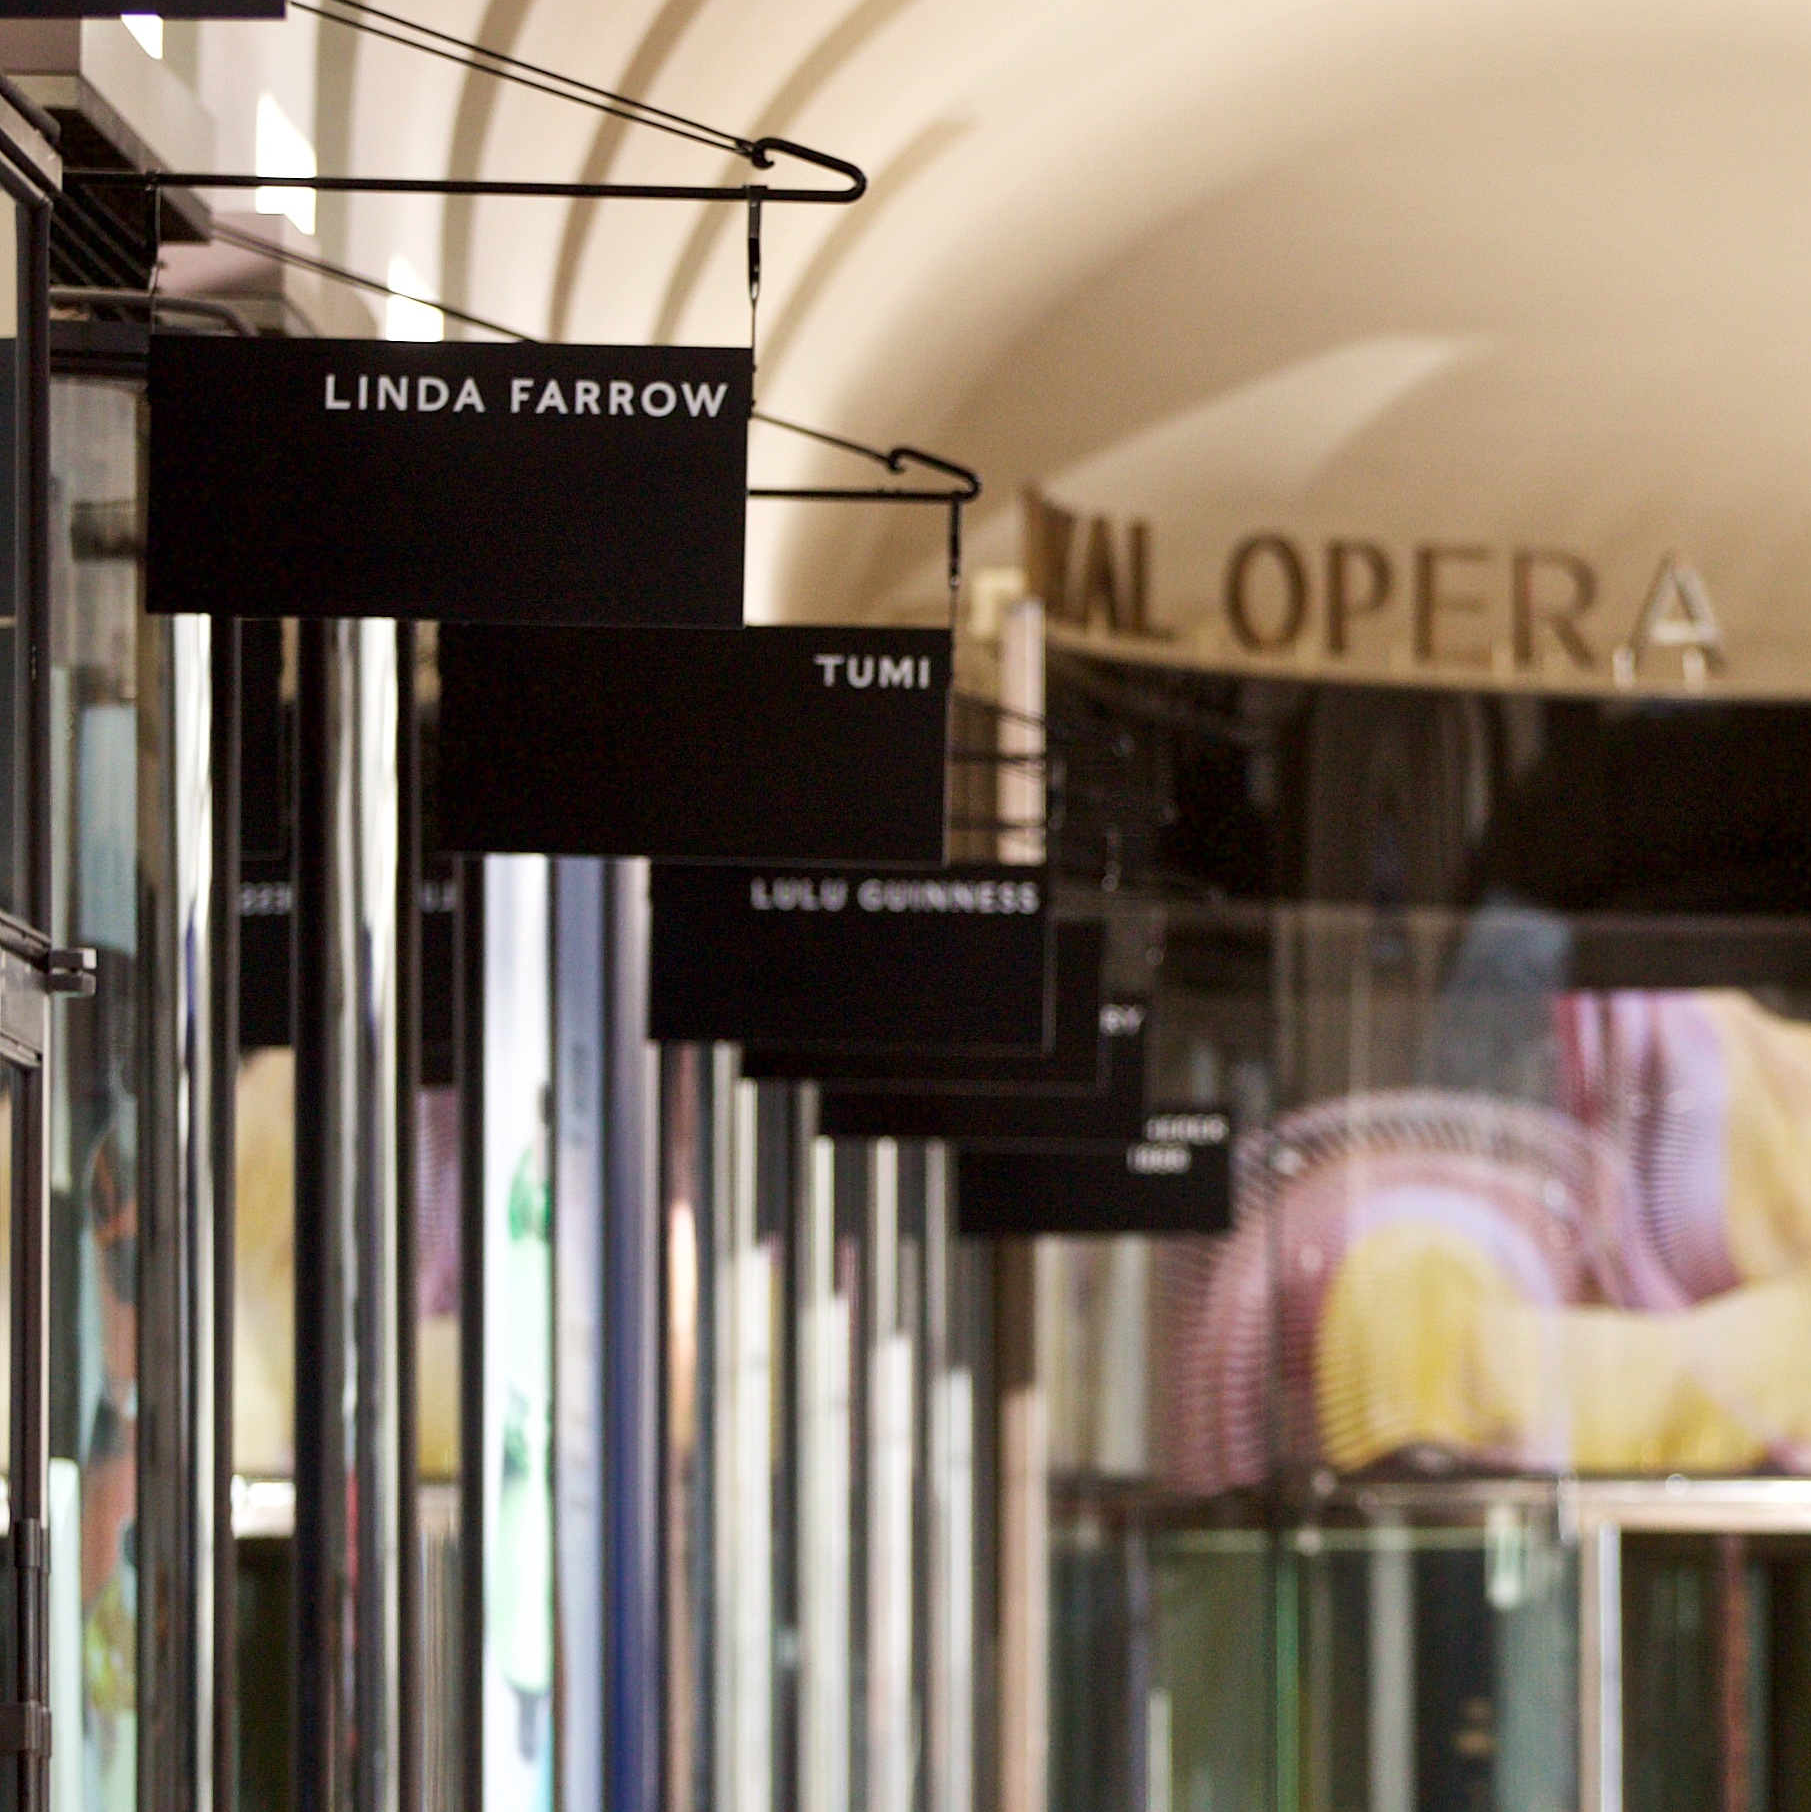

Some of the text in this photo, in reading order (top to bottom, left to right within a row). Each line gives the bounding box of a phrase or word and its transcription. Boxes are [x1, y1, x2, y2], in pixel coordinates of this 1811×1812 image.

[324, 374, 729, 418] LINDA FARROW
[1222, 531, 1728, 675] OPERA
[812, 653, 932, 690] TUMI
[750, 876, 1040, 915] LULU GUINNESS
